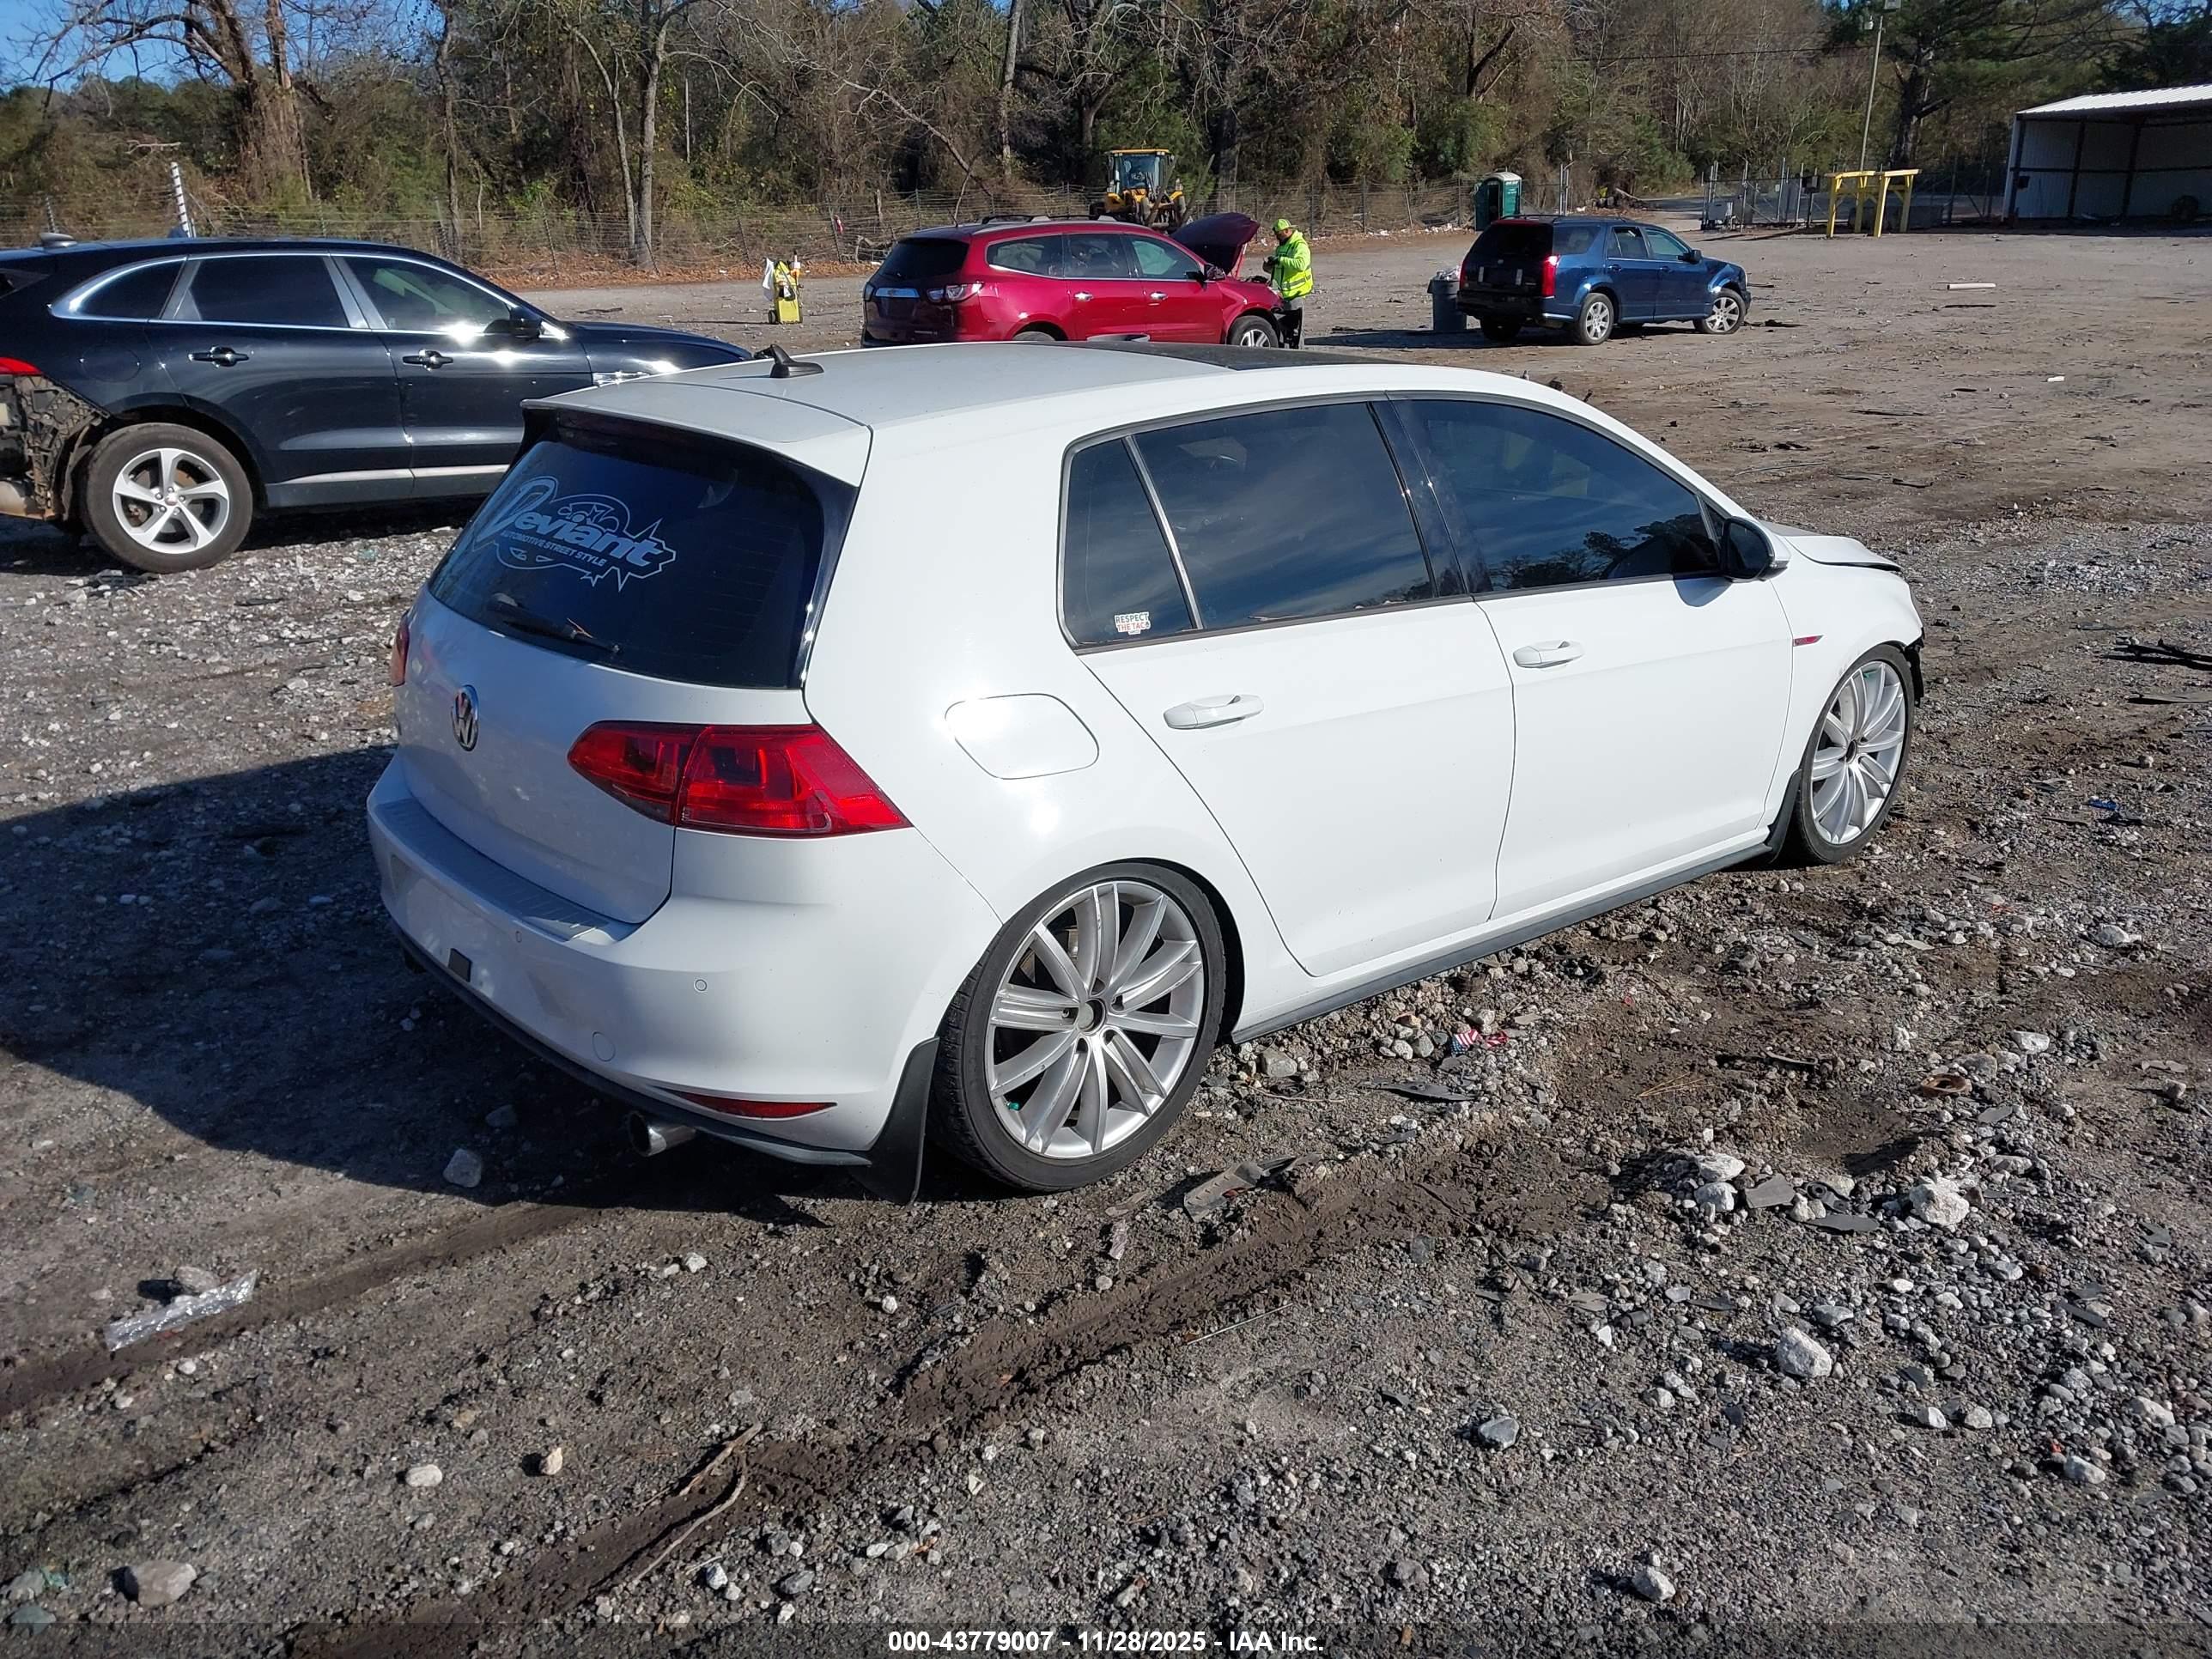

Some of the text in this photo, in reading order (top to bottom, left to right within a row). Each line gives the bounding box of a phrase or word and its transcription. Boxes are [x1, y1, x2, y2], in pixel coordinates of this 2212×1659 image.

[544, 541, 577, 556] STREET
[575, 551, 607, 567] STYLE
[1115, 613, 1148, 624] RESPECT
[1117, 623, 1132, 632] THE
